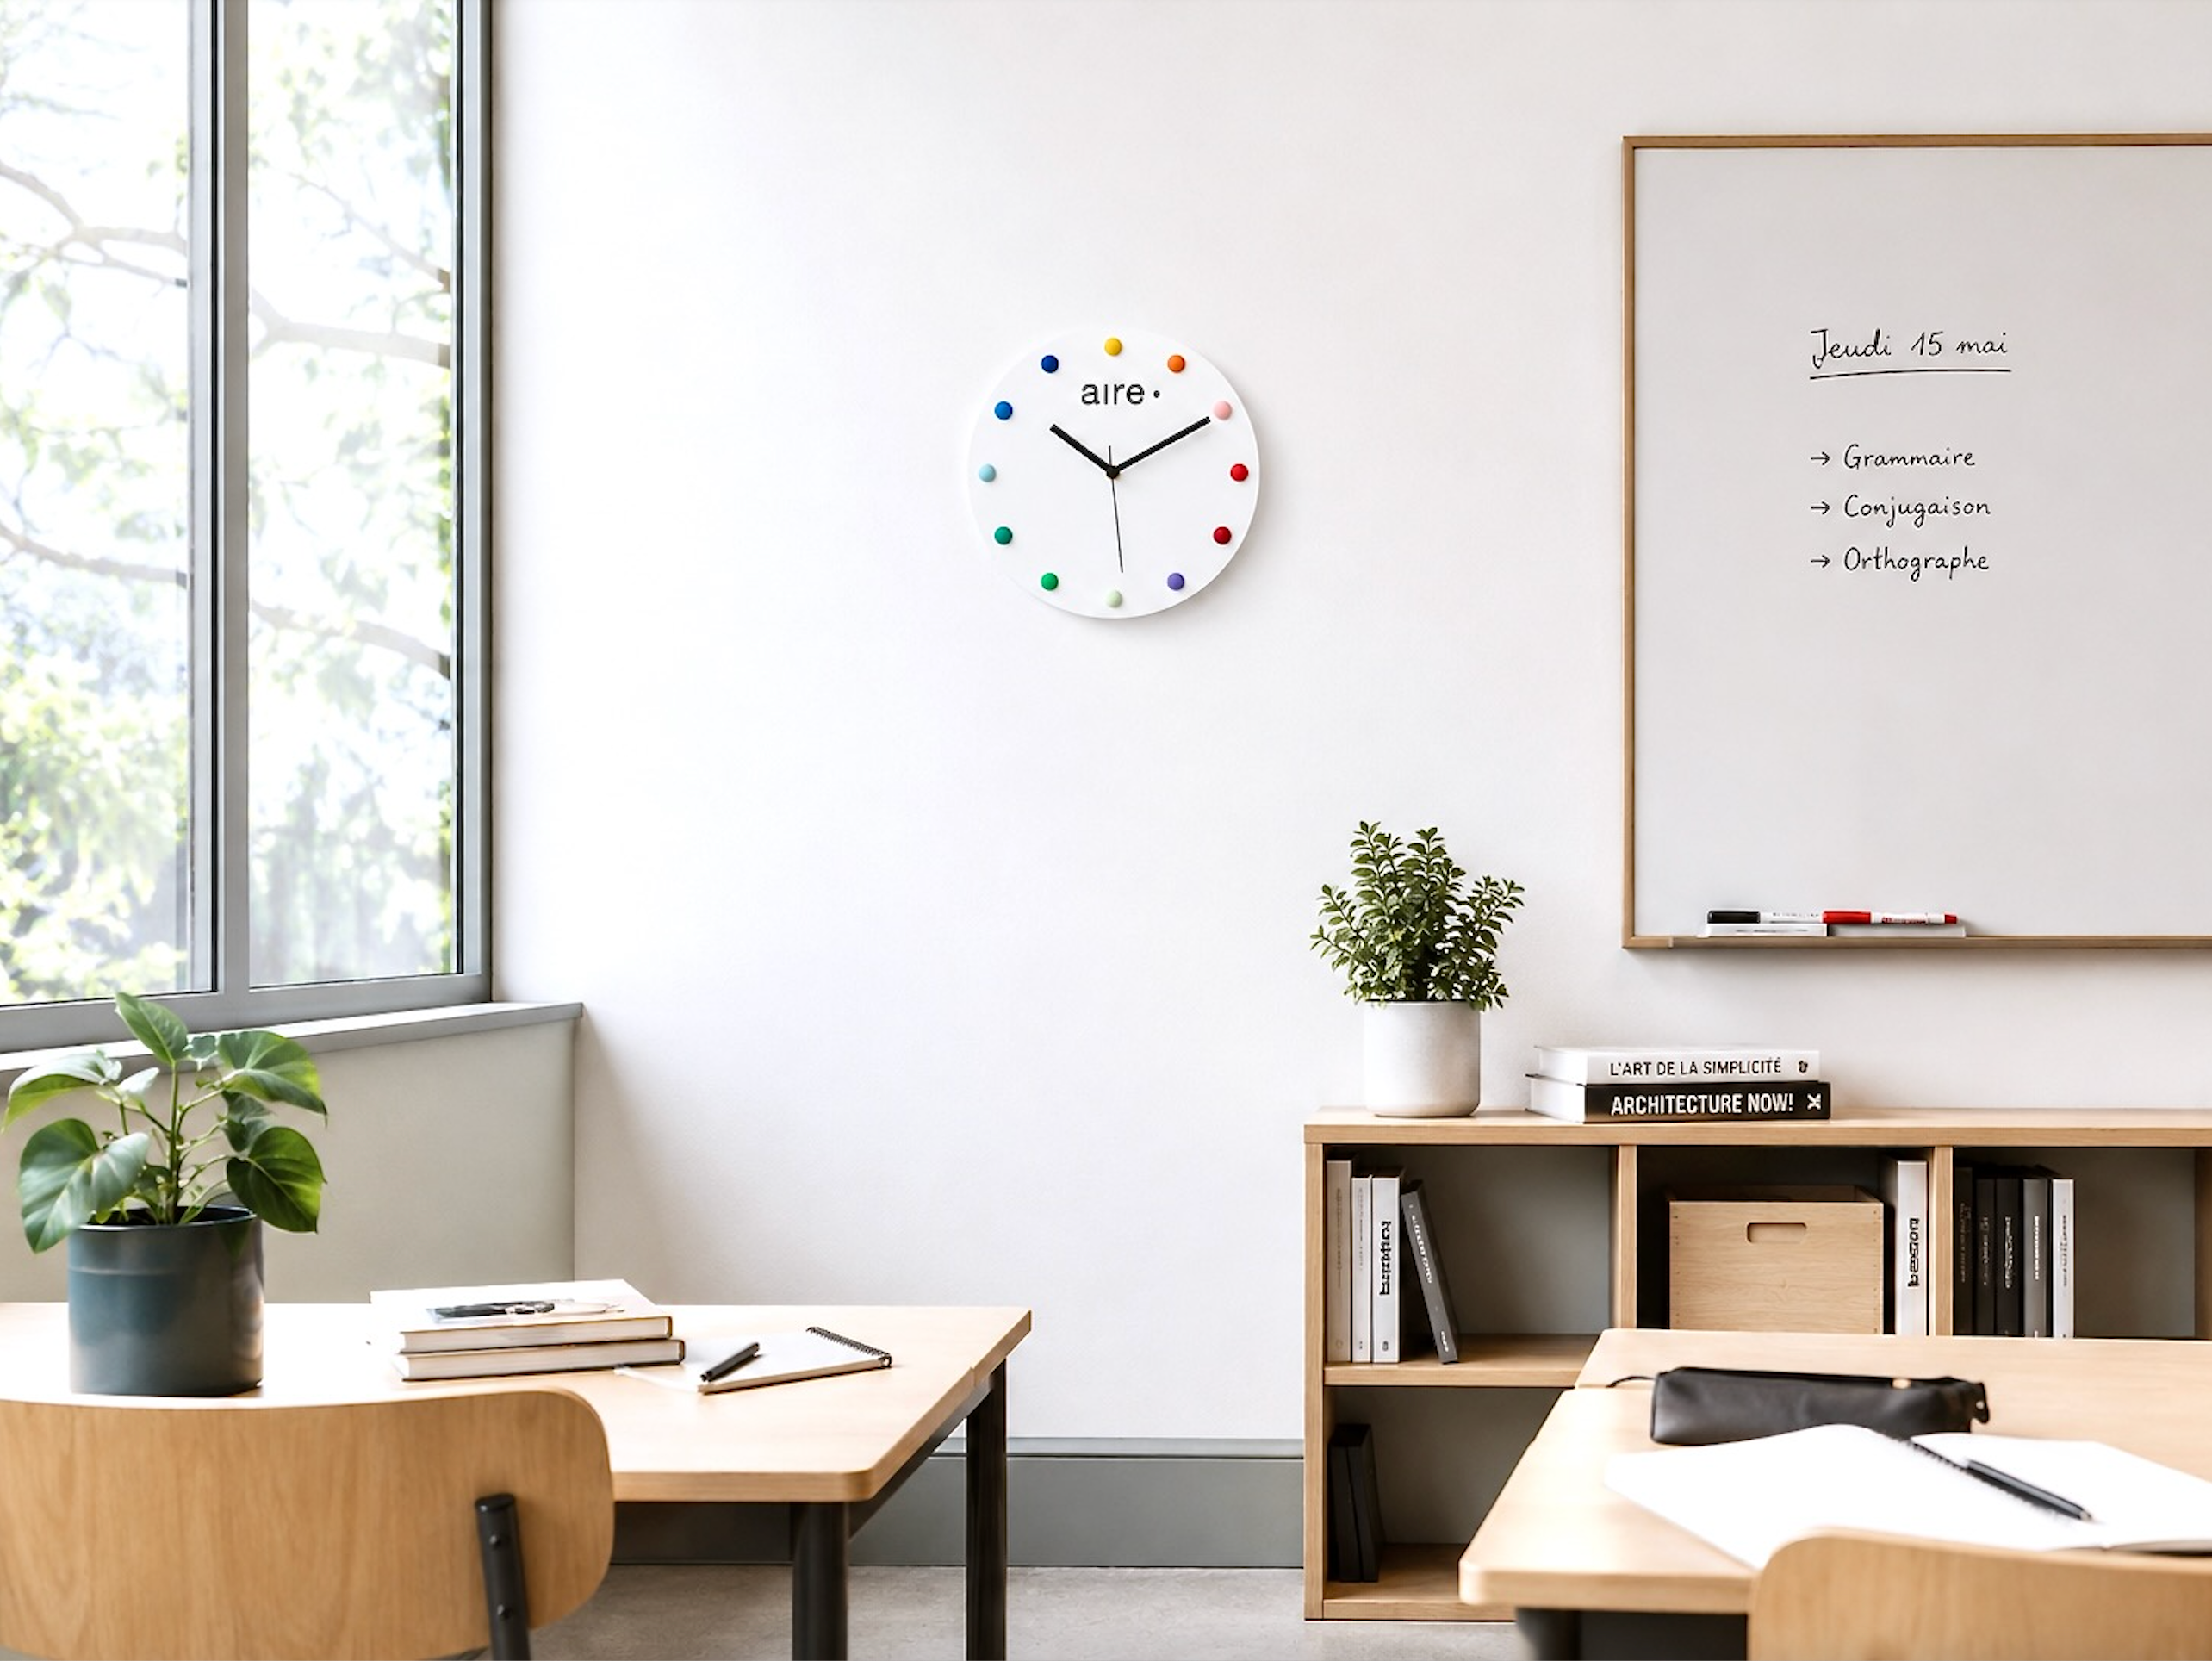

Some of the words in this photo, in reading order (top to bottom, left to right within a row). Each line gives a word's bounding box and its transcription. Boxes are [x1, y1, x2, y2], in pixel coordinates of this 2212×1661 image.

[1811, 328, 1892, 369] Jeudi
[1911, 331, 1943, 356] 15
[1955, 333, 2009, 355] mai
[1843, 444, 1976, 470] Grammaire
[1844, 494, 1991, 528] Conjugaison
[1843, 545, 1990, 582] Orthographe
[1610, 1060, 1653, 1077] L'ART
[1656, 1059, 1676, 1076] DE
[1680, 1059, 1699, 1075] LA
[1702, 1056, 1781, 1075] SIMPLICITÉ
[1611, 1092, 1743, 1116] ARCHITECTURE
[1746, 1092, 1794, 1114] NOW!
